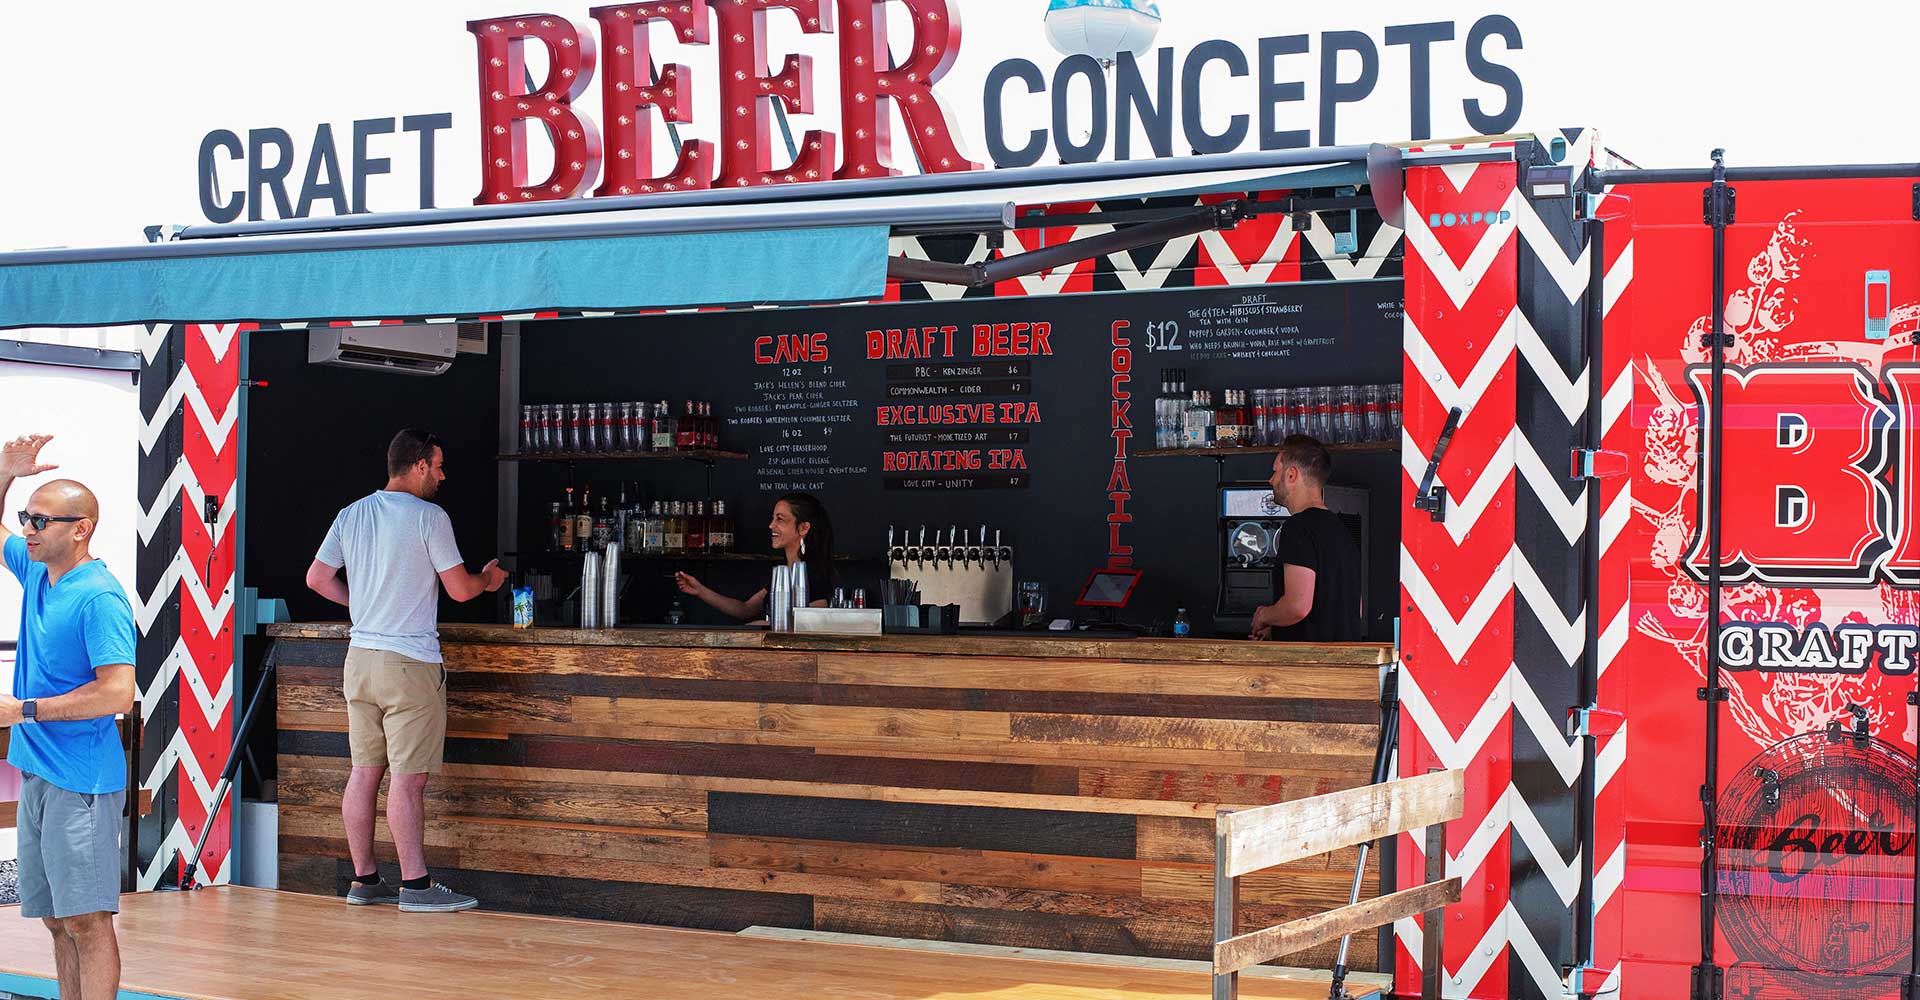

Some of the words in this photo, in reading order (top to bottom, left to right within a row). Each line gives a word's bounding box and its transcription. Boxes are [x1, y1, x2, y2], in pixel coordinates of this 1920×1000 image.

[199, 112, 452, 223] CRAFT
[467, 0, 985, 206] BEER
[984, 15, 1523, 167] CONCEPTS
[1429, 210, 1511, 228] BOXPOP
[1241, 293, 1267, 304] DRAFT
[1200, 318, 1212, 326] TEA
[1216, 317, 1232, 325] WITH
[1234, 316, 1249, 324] GIN
[1280, 326, 1300, 334] VODKA
[866, 325, 959, 360] DRAFT
[972, 322, 1054, 357] BEER
[1145, 321, 1182, 353] $12
[755, 332, 829, 364] CANS
[782, 368, 791, 376] 12
[824, 365, 833, 374] $7
[915, 366, 930, 377] PBC
[1008, 365, 1019, 375] $6
[890, 386, 948, 396] COMMONWEALTH
[959, 385, 982, 394] CIDER
[1011, 383, 1021, 392] $7
[762, 392, 787, 401] JACK'S
[832, 400, 859, 408] SELTZER
[877, 403, 995, 425] EXCLUSIVE
[999, 402, 1041, 424] IPA
[782, 429, 790, 438] 16
[791, 429, 803, 437] OZ
[823, 426, 833, 437] $9
[890, 434, 903, 442] THE
[904, 433, 932, 442] FUTURIST
[975, 432, 989, 441] ART
[1008, 432, 1019, 441] $7
[759, 445, 774, 453] LOVE
[883, 449, 982, 471] ROTATING
[988, 449, 1028, 470] IPA
[808, 482, 825, 490] CAST
[903, 479, 920, 488] LOVE
[921, 479, 936, 488] CITY
[945, 479, 974, 488] UNITY
[1010, 477, 1020, 487] $7
[1718, 623, 1919, 674] CRAFT
[1752, 813, 1916, 884] Beer
